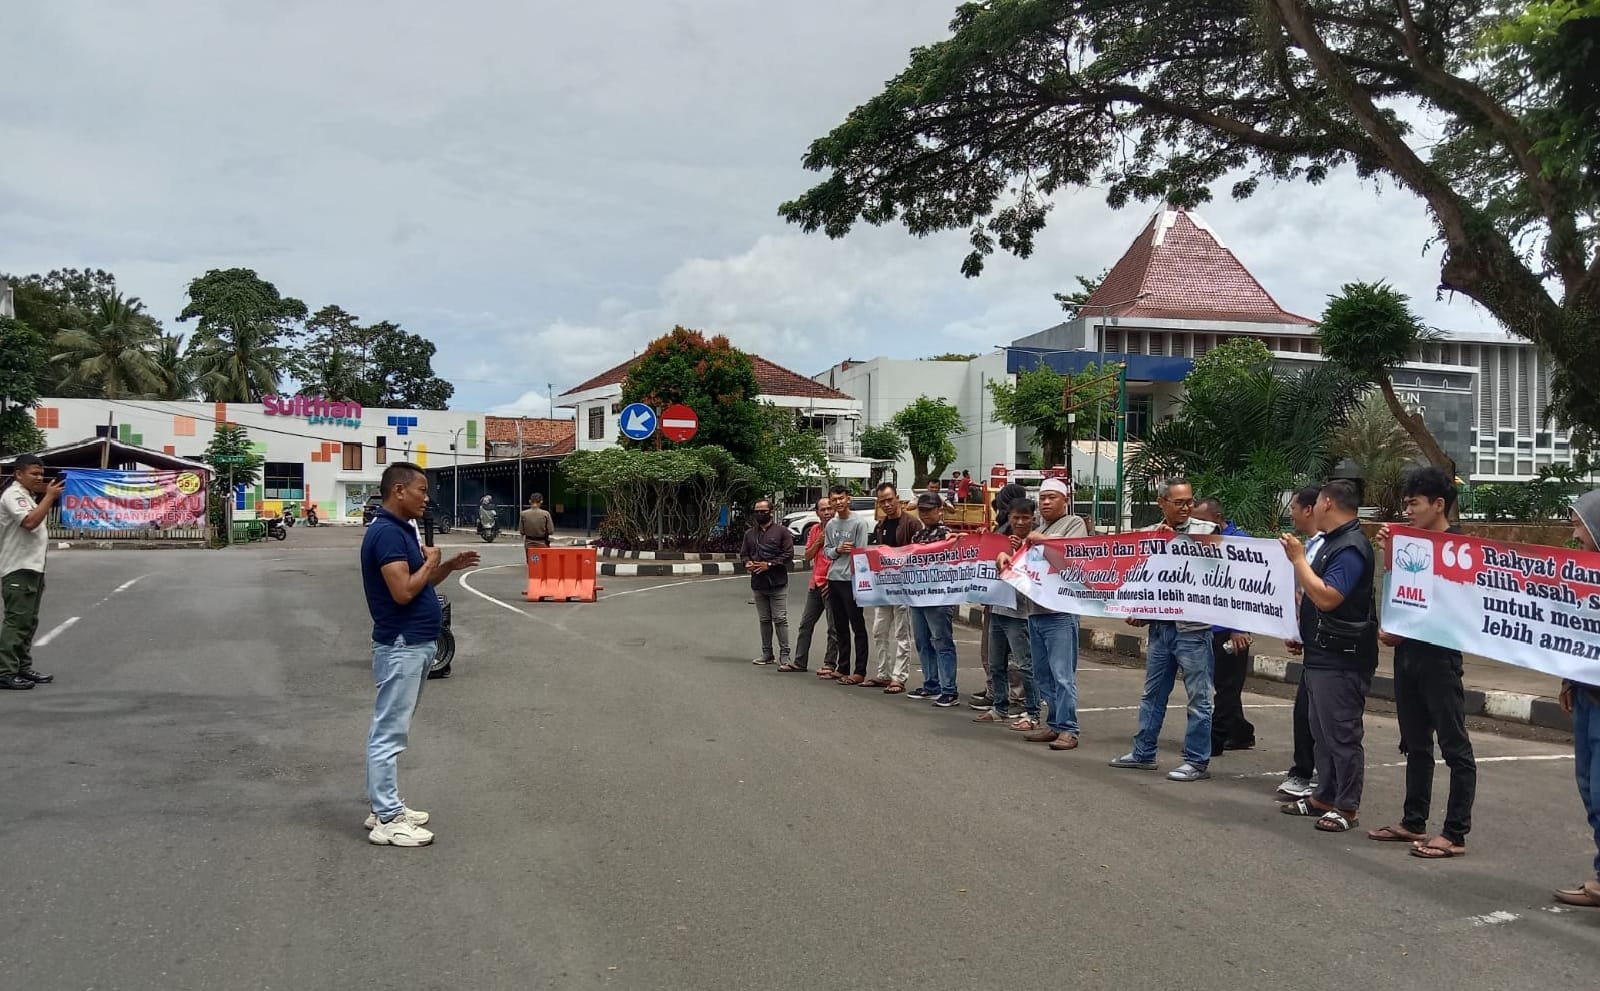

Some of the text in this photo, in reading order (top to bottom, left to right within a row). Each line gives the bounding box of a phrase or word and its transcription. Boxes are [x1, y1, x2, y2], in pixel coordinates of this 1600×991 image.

[261, 393, 362, 418] Sulthan
[65, 494, 145, 510] DAGING
[74, 511, 112, 521] HALAL
[115, 511, 141, 521] DAN
[1064, 540, 1269, 567] Rakyat dan TNI adalah Satu,
[1481, 545, 1600, 585] Rakyat dan
[1124, 559, 1154, 583] silih
[1158, 560, 1196, 586] asih,
[1202, 564, 1236, 590] silih
[1239, 569, 1276, 596] asuh
[1476, 569, 1520, 593] silih
[1526, 582, 1583, 609] asah,
[1117, 588, 1155, 600] Indonesia
[1158, 589, 1185, 601] lebih
[1187, 591, 1211, 605] aman
[1212, 594, 1229, 608] dan
[1231, 597, 1283, 618] bermartabat
[1396, 585, 1426, 603] AML
[1159, 606, 1184, 615] Lebak
[1482, 596, 1545, 622] untuk
[1482, 615, 1600, 661] lebih aman
